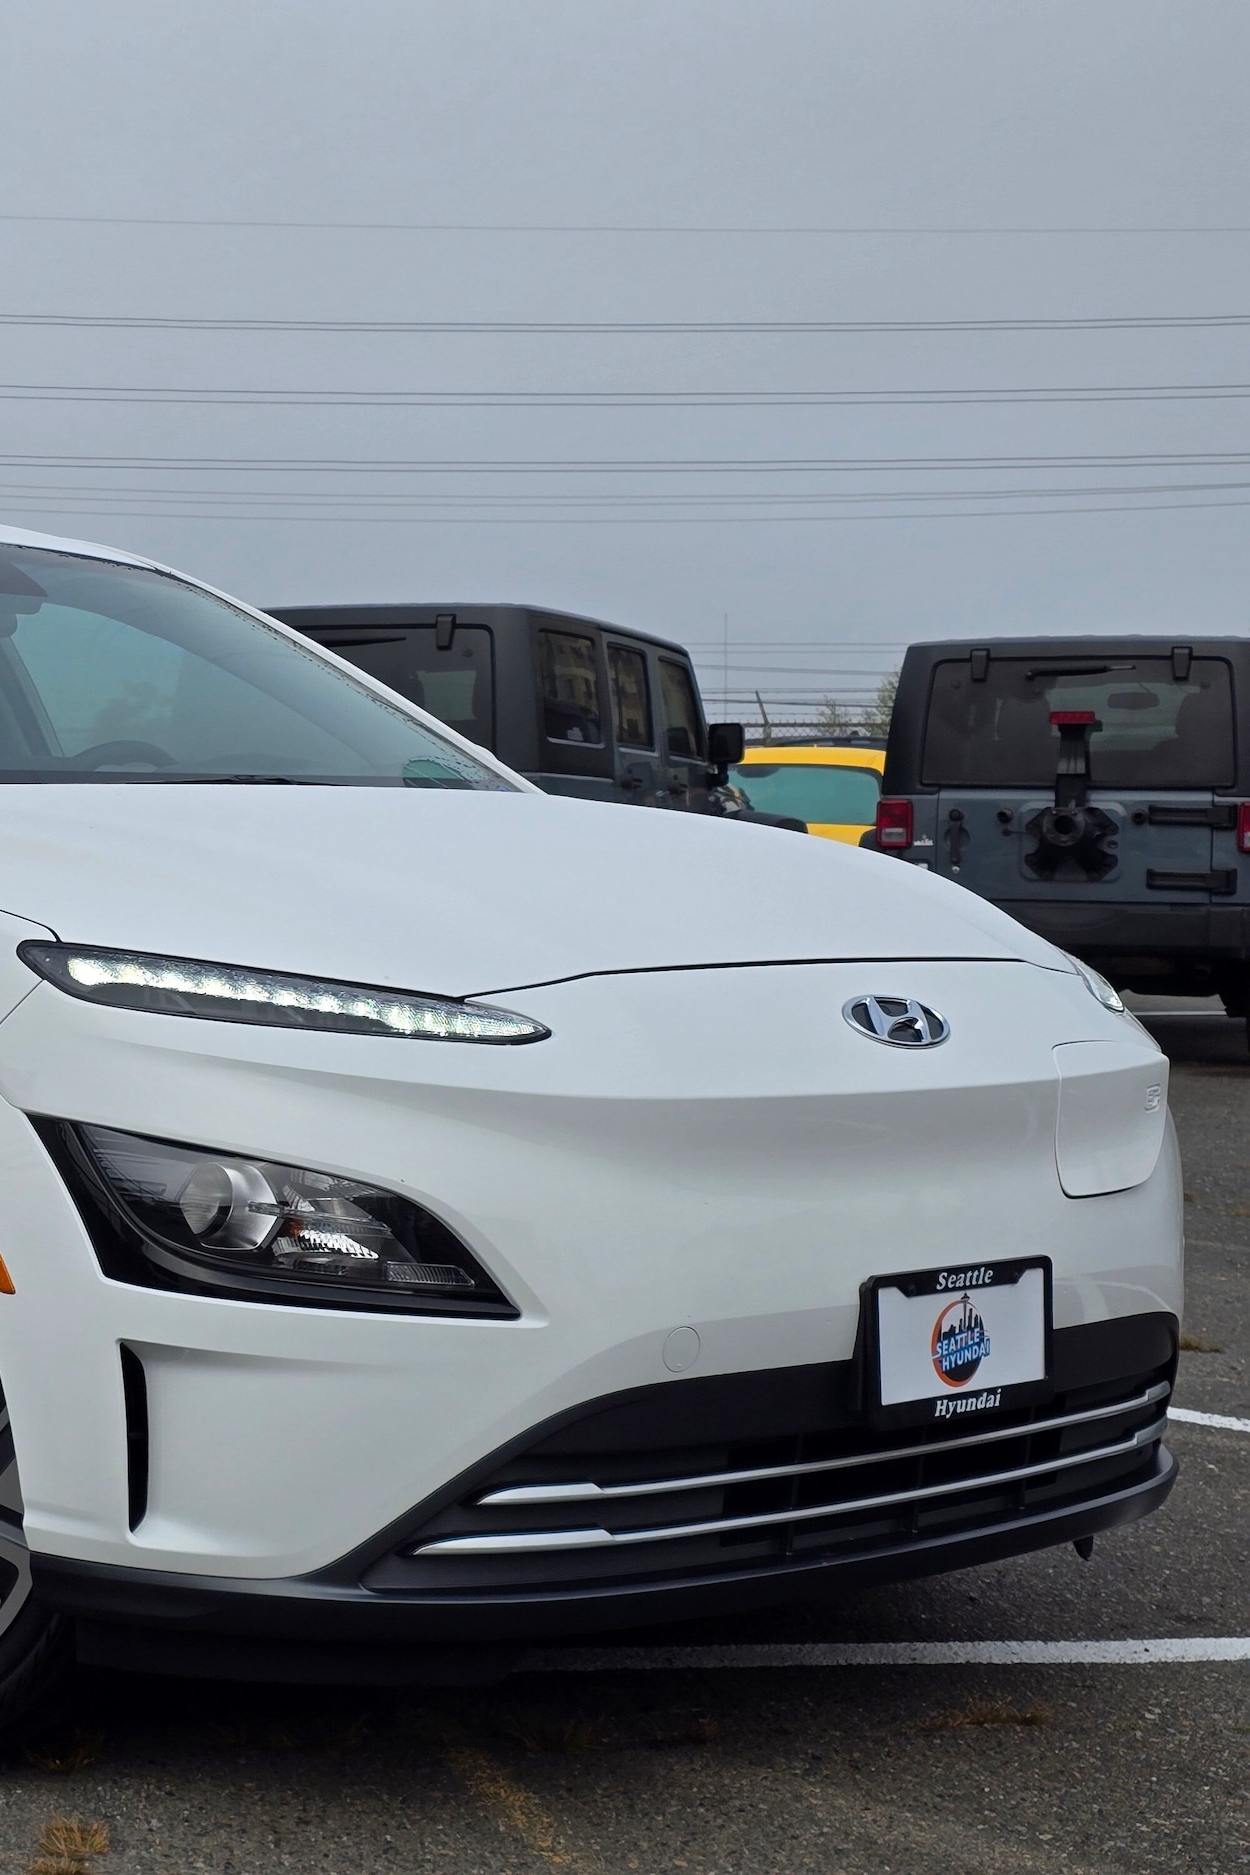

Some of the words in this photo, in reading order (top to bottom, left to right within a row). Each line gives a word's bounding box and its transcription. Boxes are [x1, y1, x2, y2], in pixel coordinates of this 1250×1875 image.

[936, 1267, 994, 1290] Seattle
[936, 1328, 981, 1357] SEATTLE
[942, 1337, 991, 1371] HYUNDAI
[935, 1388, 1002, 1419] Hyundai
